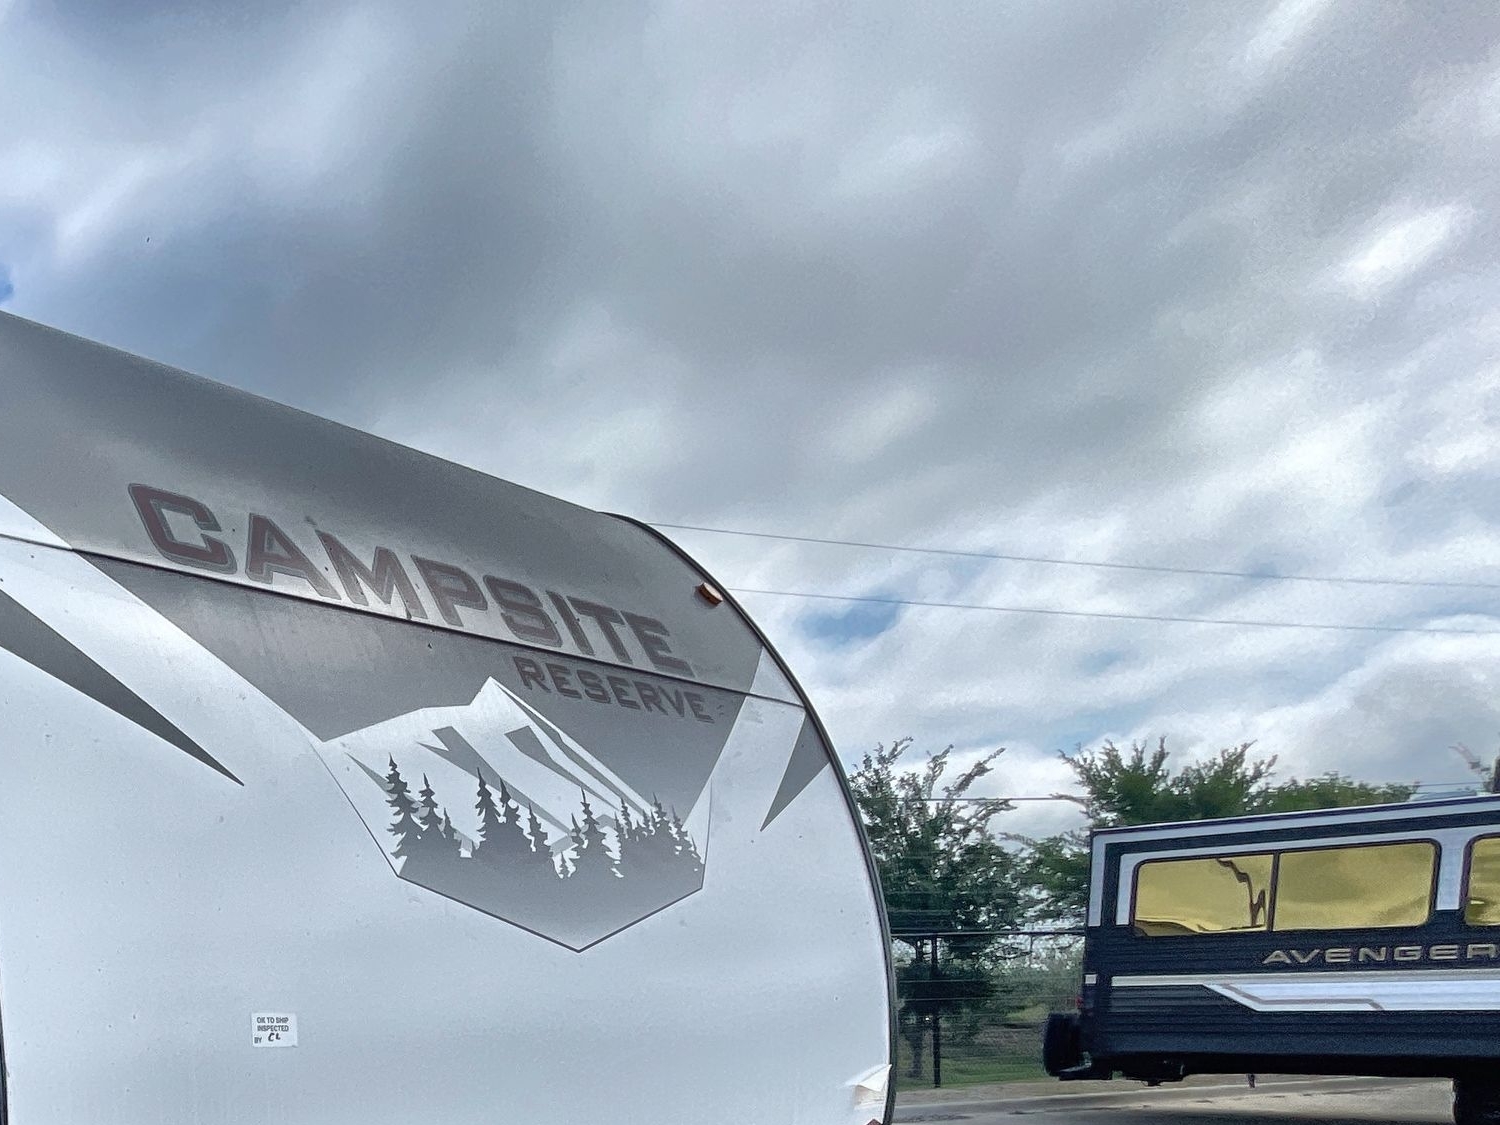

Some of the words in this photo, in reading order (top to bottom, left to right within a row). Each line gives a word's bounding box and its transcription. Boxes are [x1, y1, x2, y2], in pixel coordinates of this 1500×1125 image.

[127, 482, 696, 678] CAMPSITE
[512, 655, 715, 725] RESERVE
[1263, 943, 1500, 965] AVENGER
[257, 1024, 289, 1032] INSPECTED
[266, 1016, 275, 1024] TO
